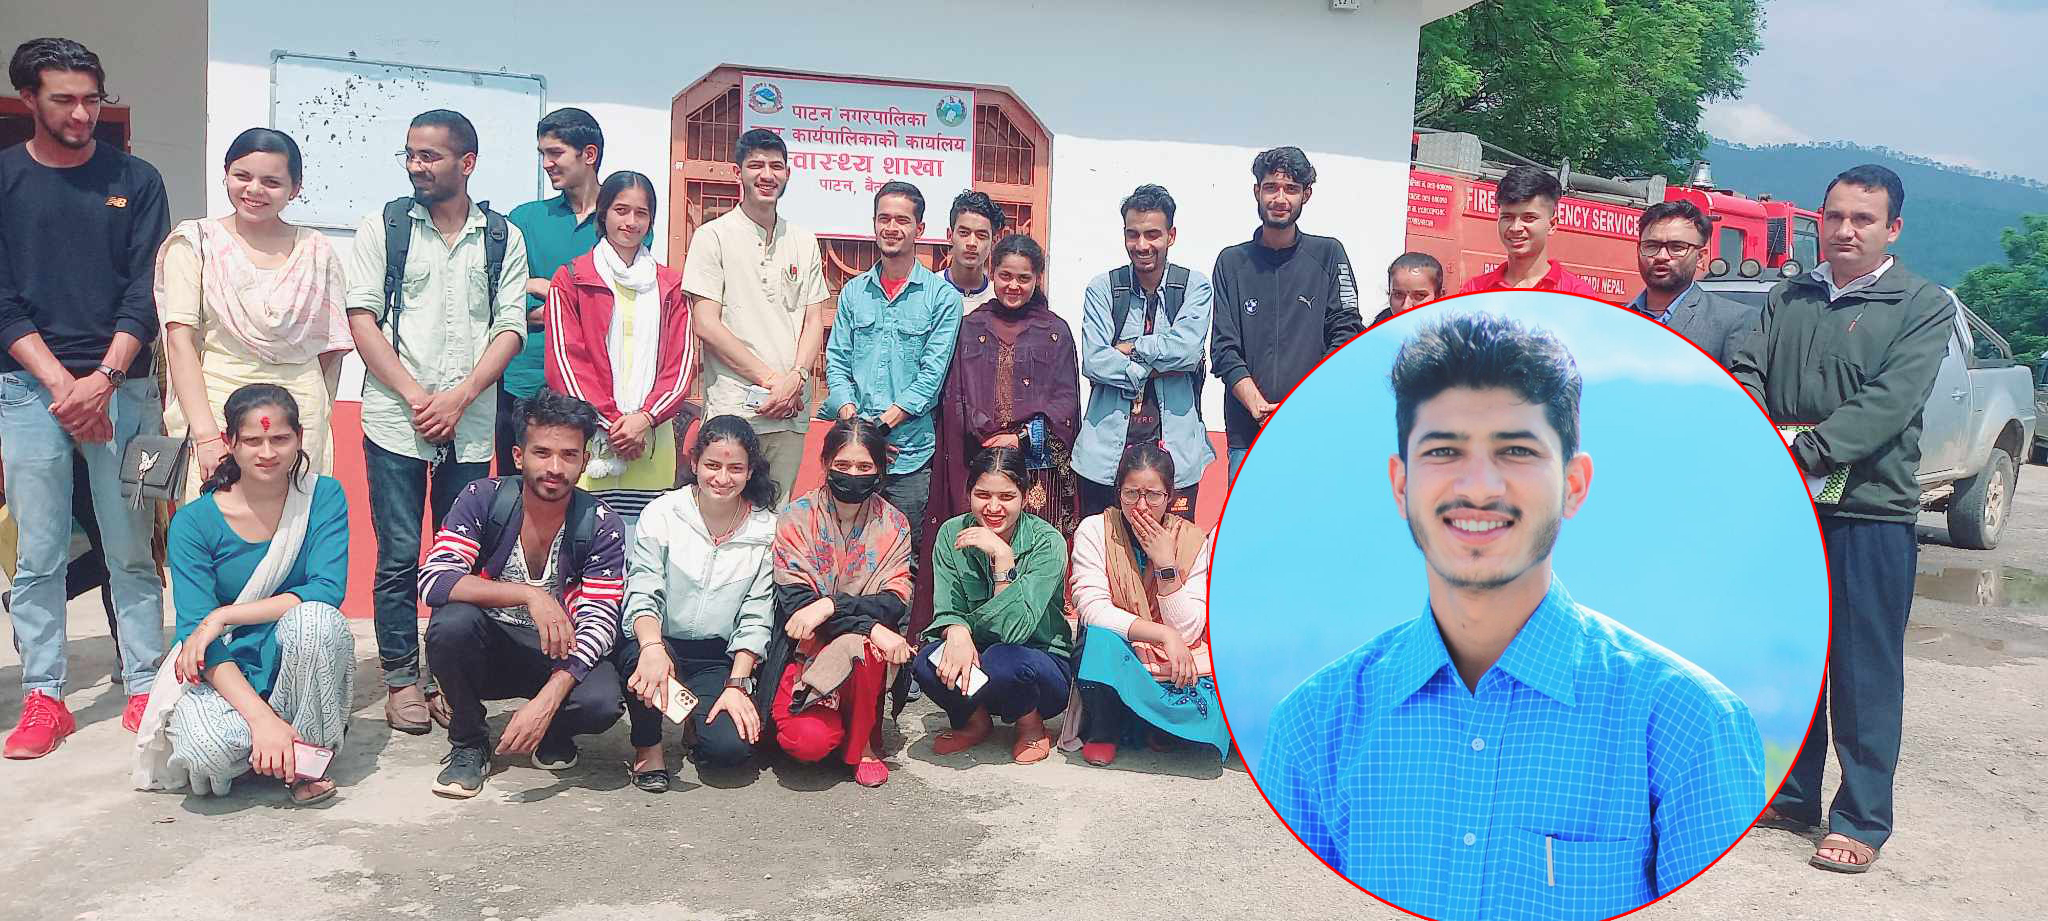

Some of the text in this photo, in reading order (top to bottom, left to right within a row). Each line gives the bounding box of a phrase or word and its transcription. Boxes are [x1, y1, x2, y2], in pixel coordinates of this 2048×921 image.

[792, 105, 928, 127] पाटन नगरपालिका
[792, 126, 899, 148] कार्यपालिकाको
[906, 132, 966, 152] कार्यालय
[883, 156, 945, 177] शाखा
[1465, 186, 1497, 214] FIRE
[1557, 202, 1590, 229] ENCY
[1602, 277, 1625, 295] NEPAL
